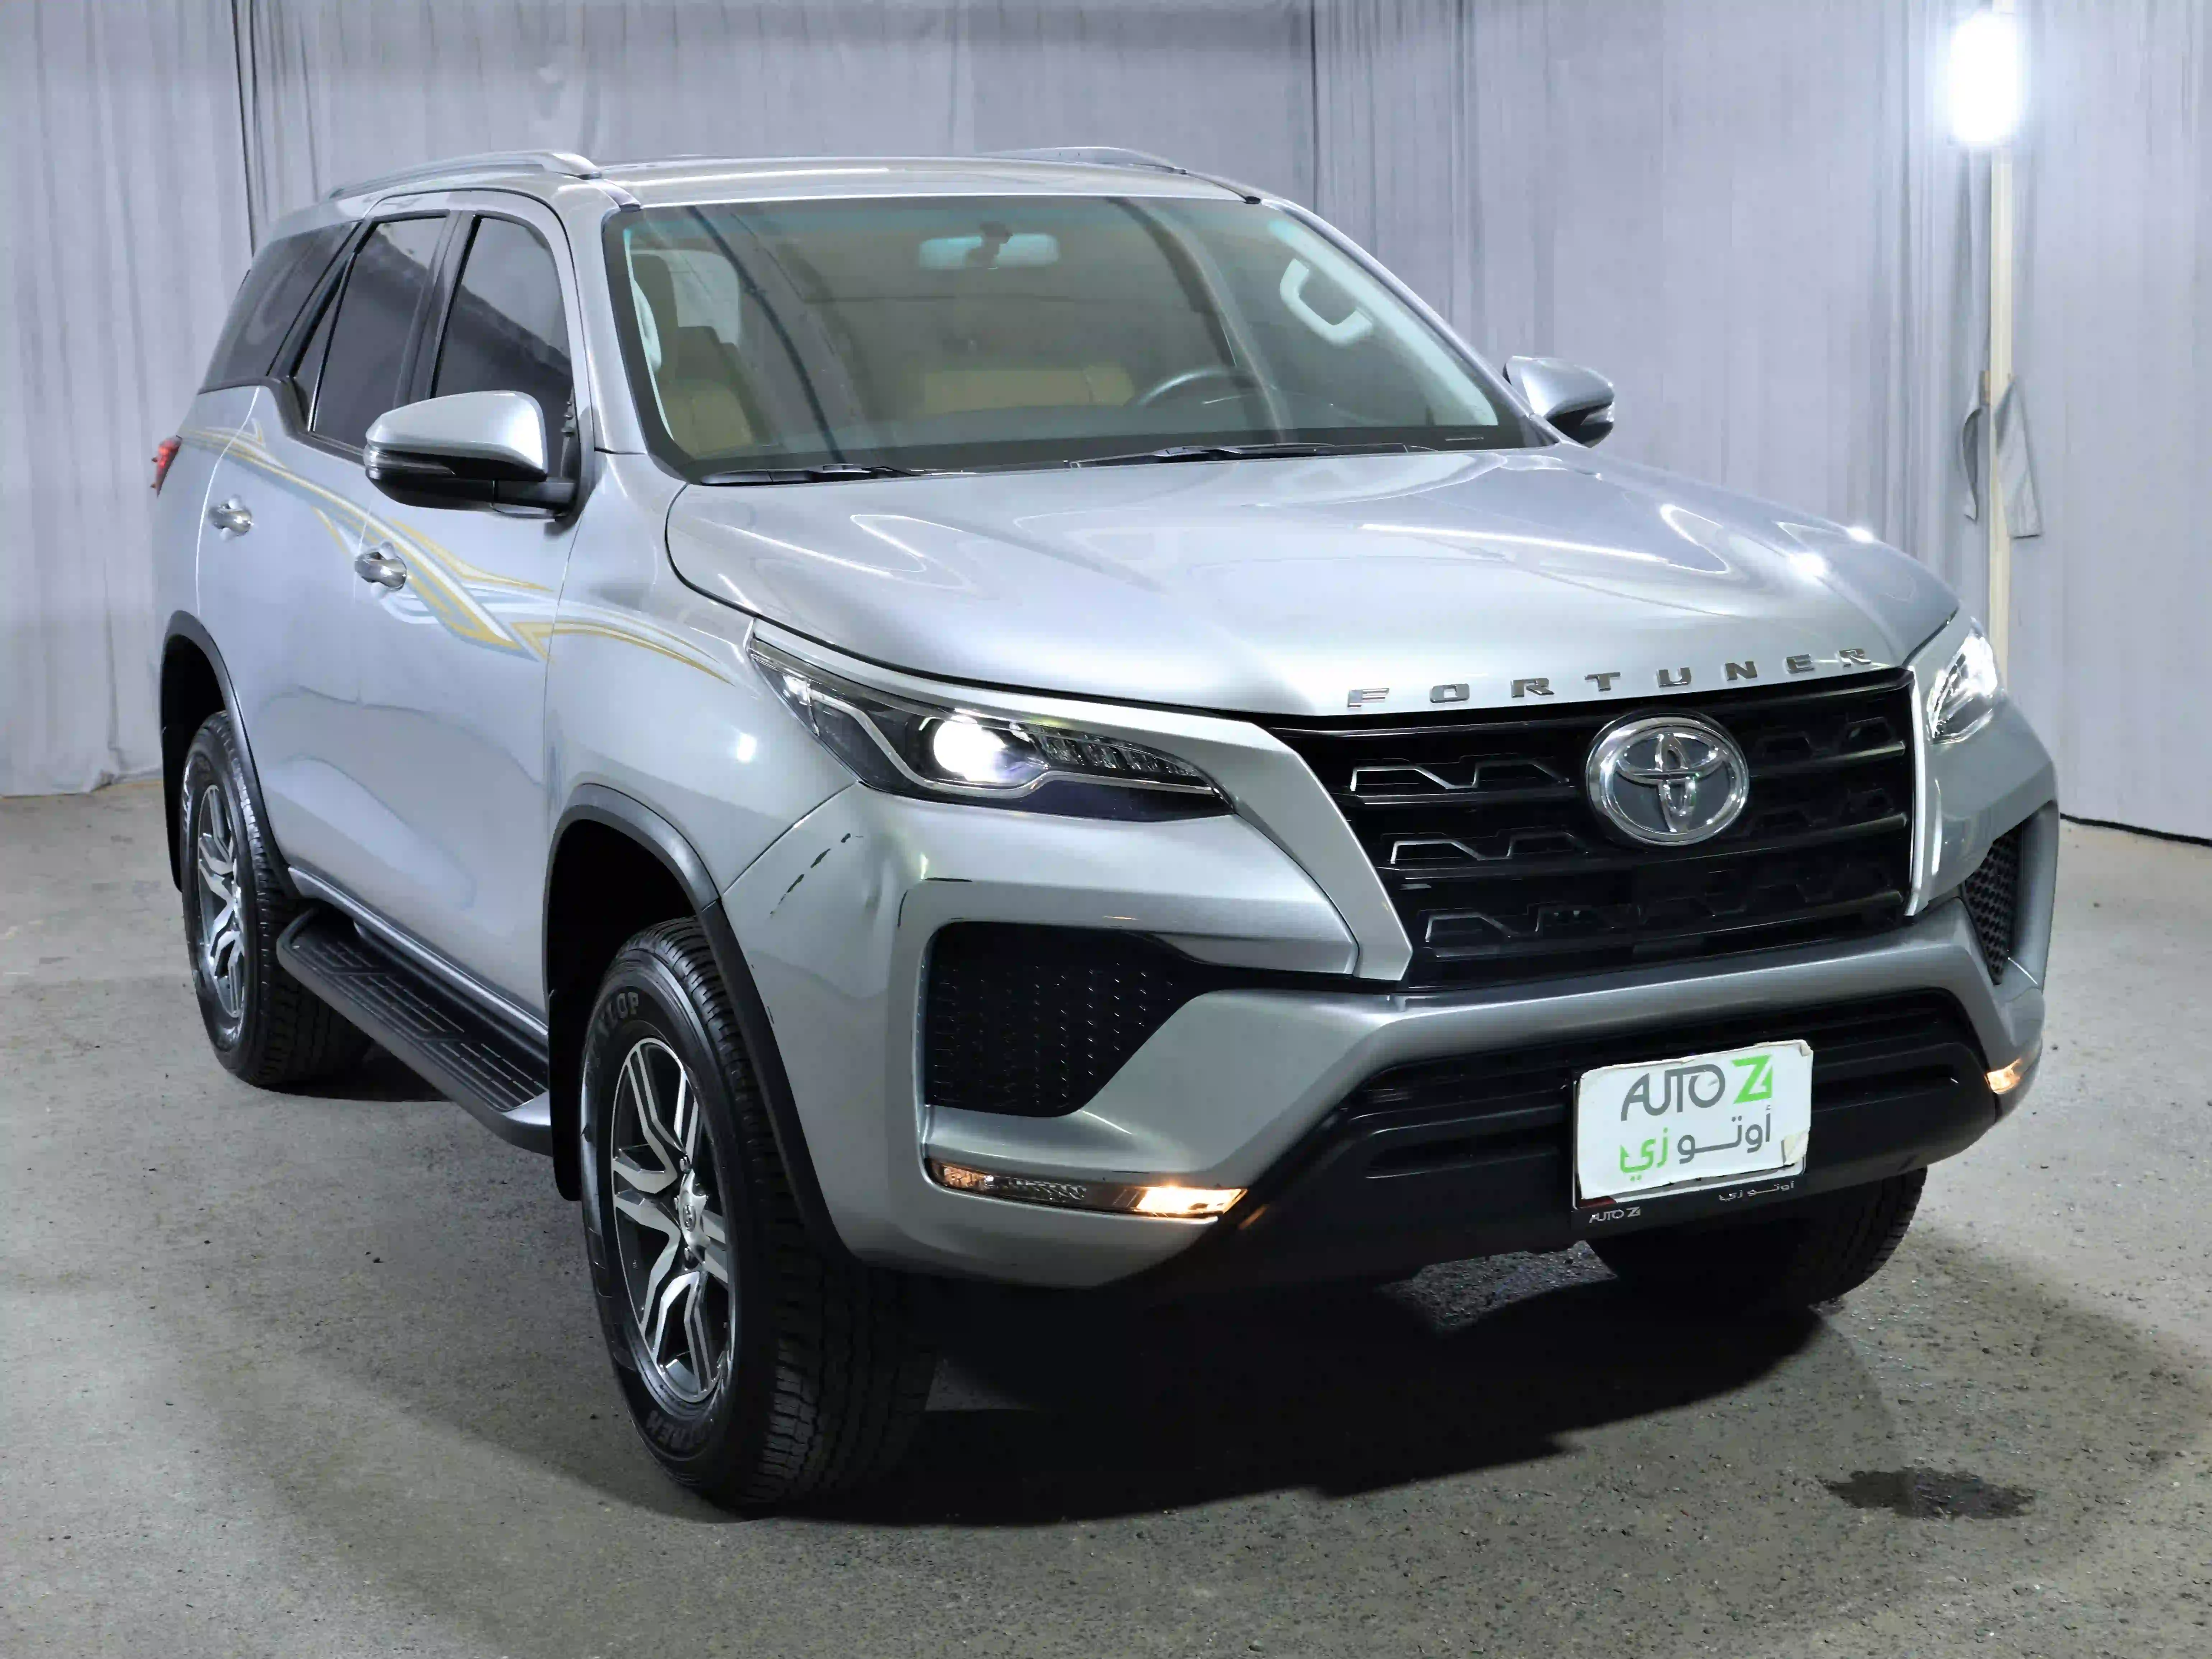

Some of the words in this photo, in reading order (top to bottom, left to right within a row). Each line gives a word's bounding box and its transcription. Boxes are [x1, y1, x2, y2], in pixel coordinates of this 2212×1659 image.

[1347, 647, 1871, 708] FORTUNER
[1621, 1064, 1726, 1121] AUTO
[1620, 1128, 1669, 1182] زي
[1589, 1209, 1624, 1223] AUTO
